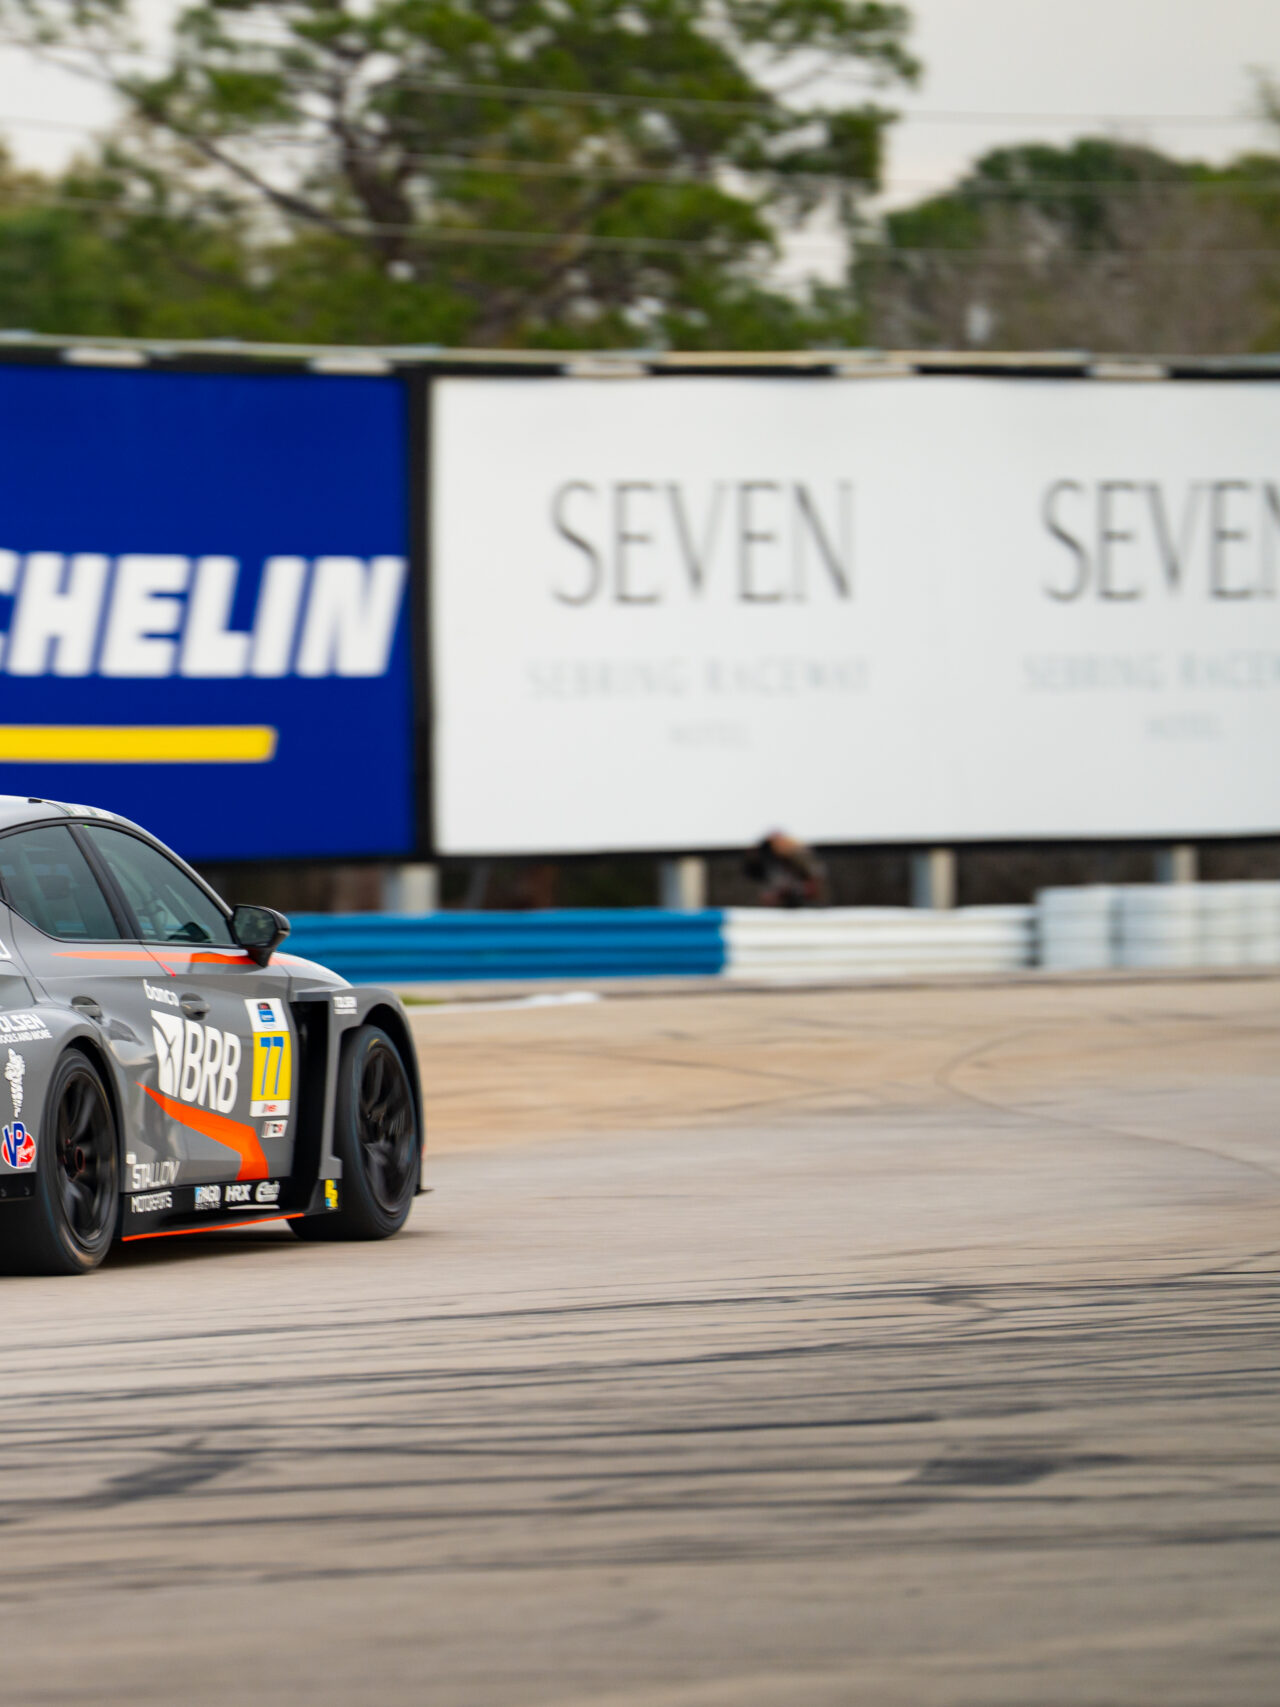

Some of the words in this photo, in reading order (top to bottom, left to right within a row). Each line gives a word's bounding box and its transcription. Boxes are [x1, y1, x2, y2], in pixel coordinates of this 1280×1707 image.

[548, 478, 854, 607] SEVEN
[180, 1019, 242, 1114] BRB
[260, 1036, 284, 1096] 77
[3, 1122, 26, 1167] VP
[224, 1184, 252, 1202] HRX
